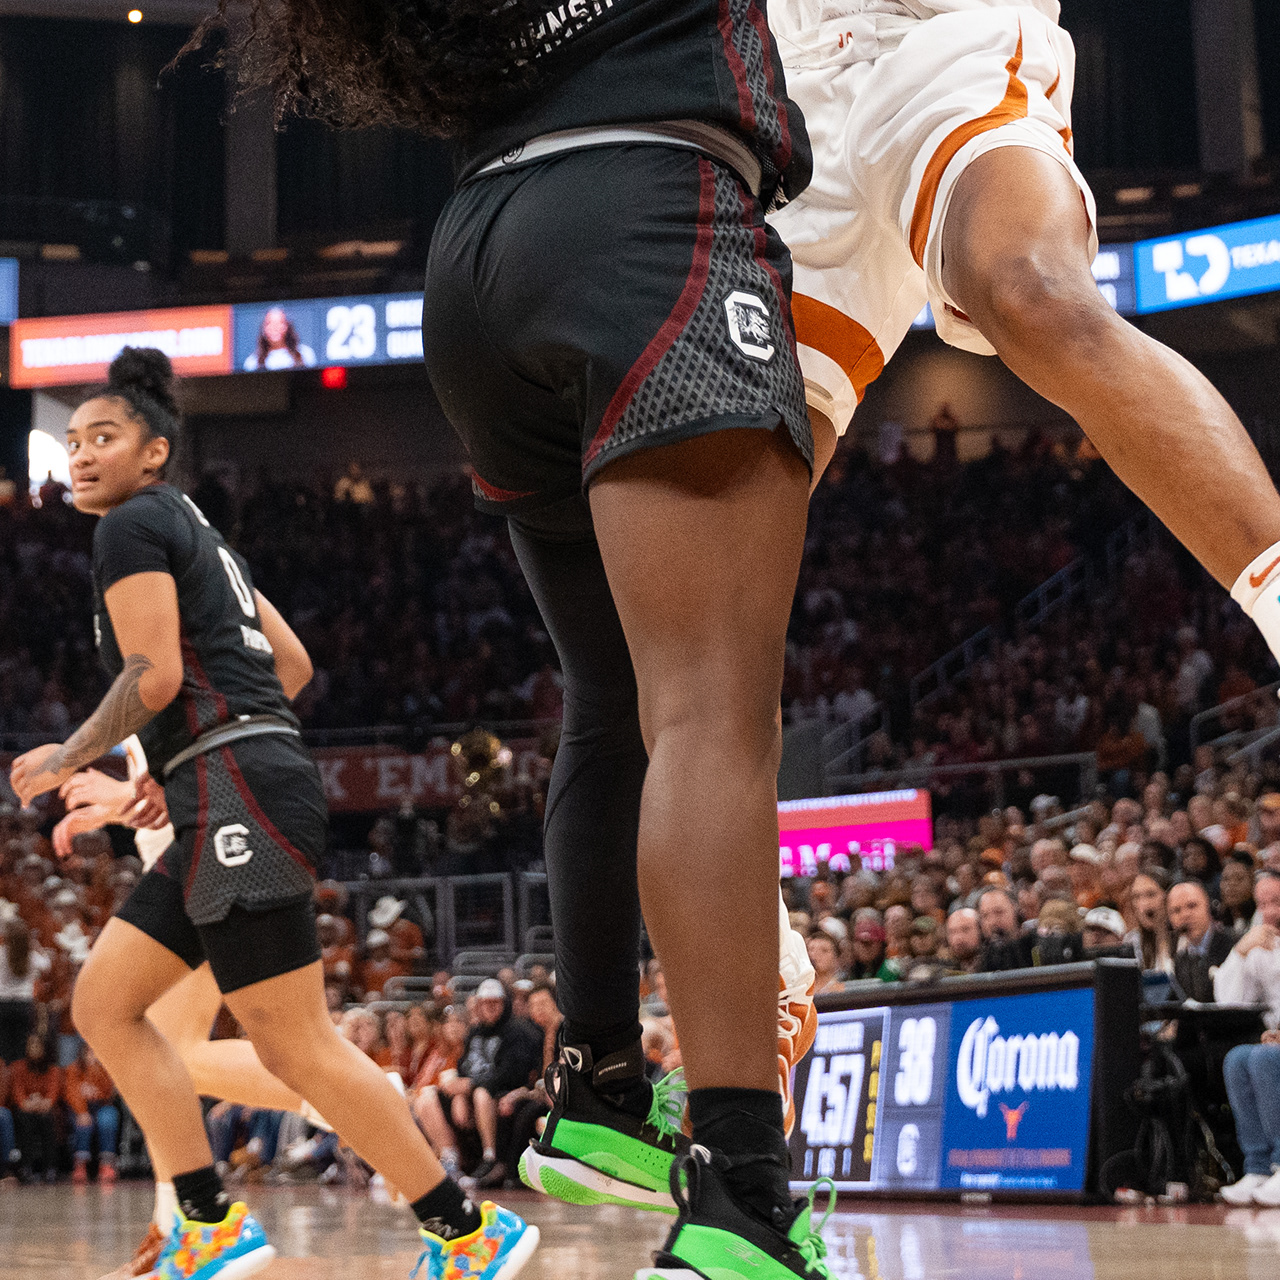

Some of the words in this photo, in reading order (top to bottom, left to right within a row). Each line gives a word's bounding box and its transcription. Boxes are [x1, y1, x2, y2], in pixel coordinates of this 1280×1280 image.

[326, 304, 376, 361] 23
[800, 1053, 865, 1147] 4:57
[894, 1017, 936, 1106] 38
[956, 1015, 1079, 1118] Corona
